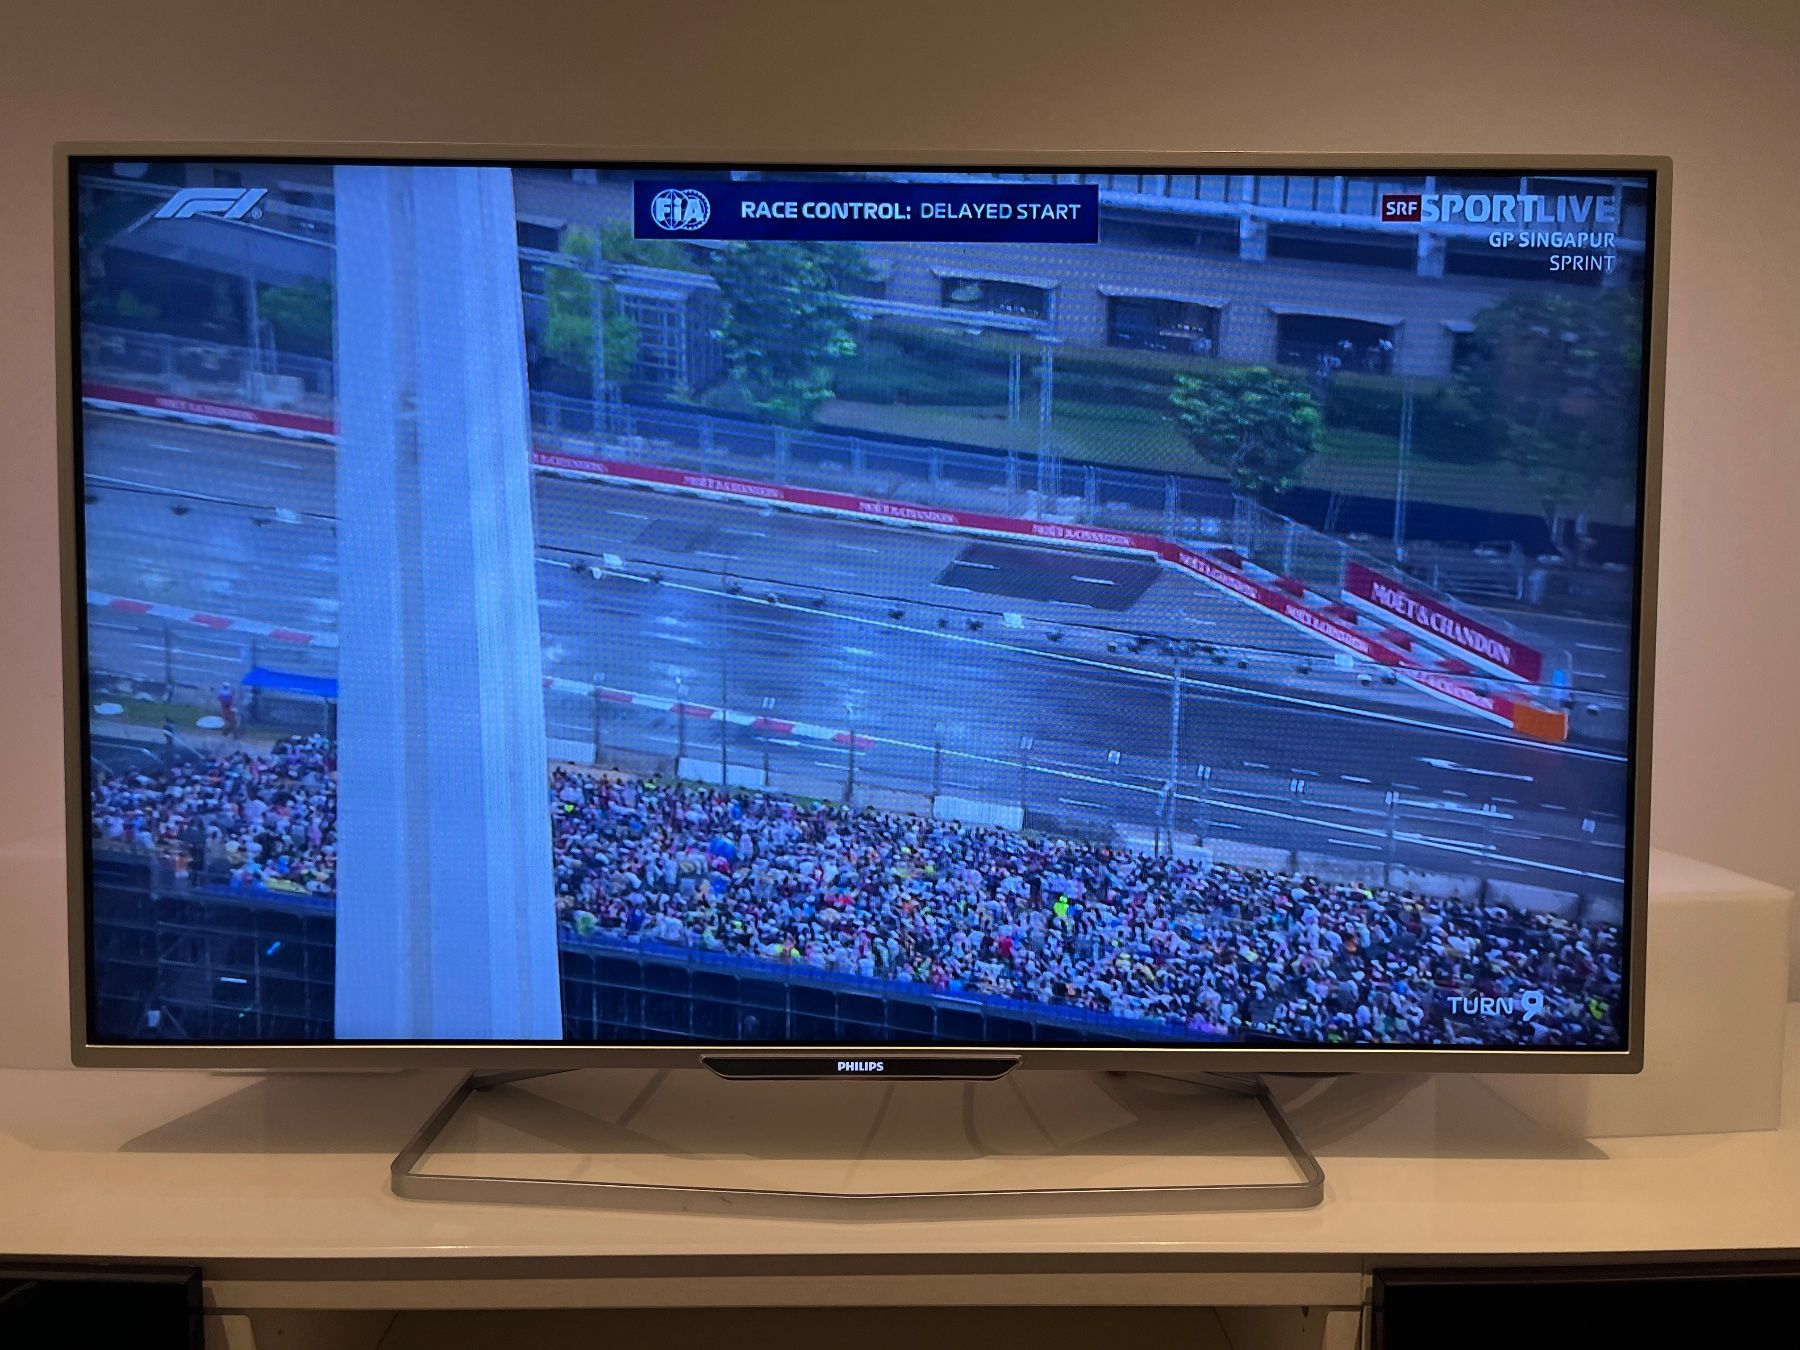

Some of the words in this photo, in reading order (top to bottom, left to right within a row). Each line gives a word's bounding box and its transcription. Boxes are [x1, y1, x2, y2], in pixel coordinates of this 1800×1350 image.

[741, 201, 798, 219] RACE
[802, 202, 911, 220] CONTROL:
[921, 203, 1012, 219] DELAYED
[1017, 204, 1081, 220] START
[1386, 202, 1418, 216] SRF
[1489, 232, 1515, 248] GP
[1519, 232, 1616, 248] SINGAPUR
[1549, 255, 1616, 272] SPRINT
[1447, 997, 1514, 1016] TURN
[1521, 990, 1544, 1022] 9
[837, 1061, 884, 1071] PHILIPS
